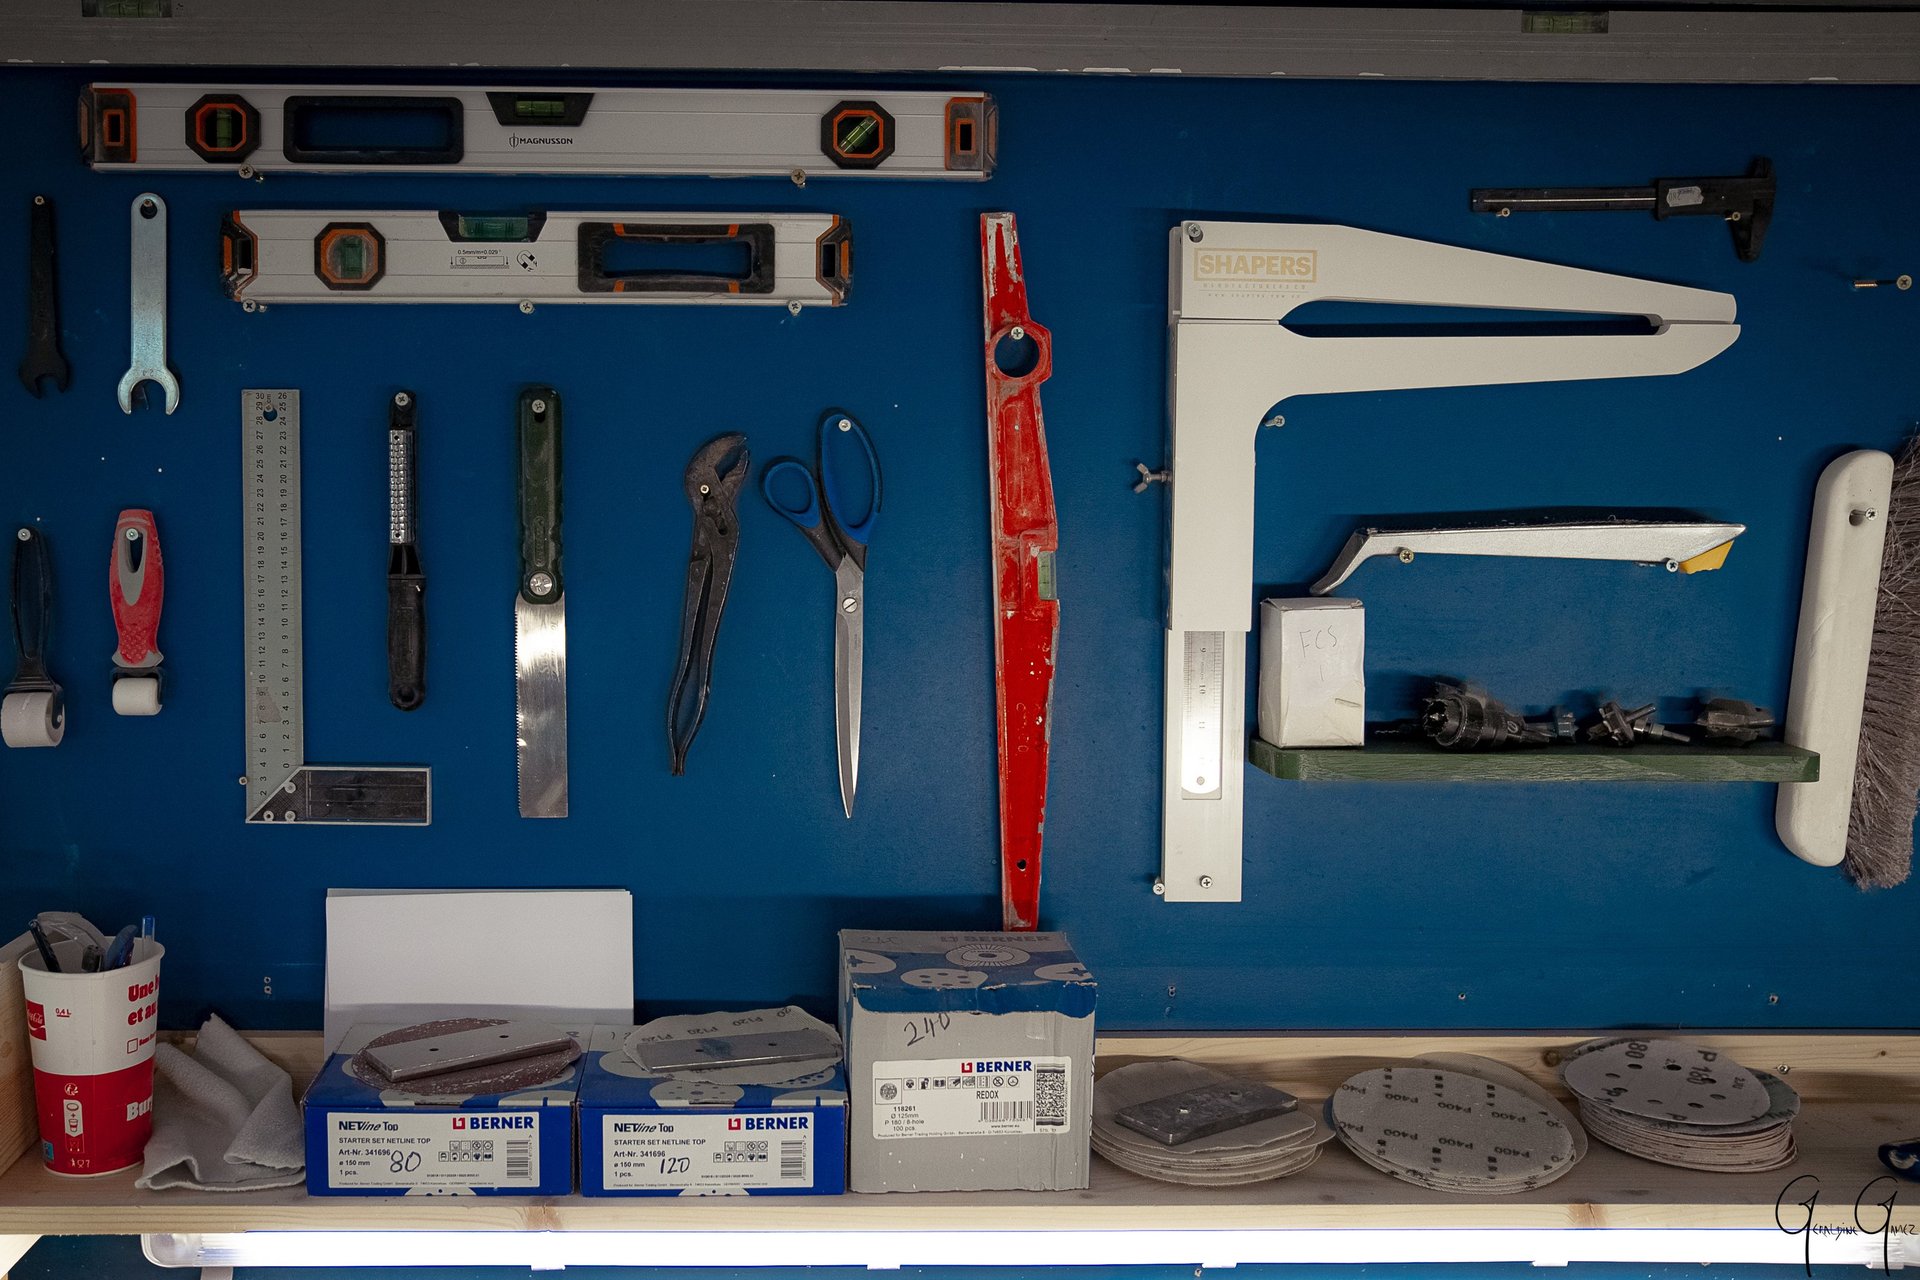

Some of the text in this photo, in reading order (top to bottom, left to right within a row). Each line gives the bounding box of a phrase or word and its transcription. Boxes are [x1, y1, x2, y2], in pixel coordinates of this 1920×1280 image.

[1200, 254, 1312, 276] SHAPERS
[256, 402, 263, 410] 29
[279, 402, 286, 411] 25
[256, 416, 263, 425] 28
[279, 417, 286, 425] 24
[256, 431, 263, 439] 27
[280, 431, 286, 440] 23
[256, 445, 263, 454] 26
[280, 446, 286, 454] 22
[256, 460, 263, 468] 25
[280, 460, 286, 468] 21
[257, 474, 263, 483] 24
[280, 475, 287, 483] 20
[257, 489, 264, 497] 23
[280, 489, 287, 497] 19
[257, 503, 264, 512] 22
[280, 504, 287, 512] 18
[257, 517, 264, 525] 21
[280, 518, 287, 526] 17
[257, 532, 264, 540] 20
[280, 532, 287, 540] 16
[257, 546, 264, 554] 19
[281, 547, 287, 555] 15
[258, 561, 264, 569] 18
[281, 561, 287, 569] 14
[258, 575, 264, 583] 17
[281, 575, 288, 583] 13
[258, 589, 265, 597] 16
[258, 603, 265, 611] 15
[258, 618, 265, 626] 14
[281, 618, 288, 627] 10
[258, 632, 265, 640] 13
[1300, 624, 1337, 658] FCS
[259, 646, 265, 654] 12
[259, 675, 265, 683] 10
[1199, 685, 1206, 694] 10
[128, 980, 154, 1002] Une
[128, 1007, 143, 1025] et
[732, 1016, 764, 1026] P120
[687, 1026, 718, 1035] P120
[904, 1012, 950, 1047] 240
[976, 1061, 1032, 1073] BERNER
[977, 1090, 999, 1099] REDOX
[1385, 1093, 1418, 1103] P400
[1438, 1102, 1471, 1113] P400
[1491, 1111, 1526, 1123] P400
[382, 1121, 399, 1131] Top
[470, 1116, 534, 1129] BERNER
[745, 1117, 809, 1130] BERNER
[658, 1123, 674, 1133] Top
[1384, 1129, 1418, 1140] P400
[1439, 1138, 1473, 1149] P400
[1494, 1147, 1530, 1158] P400
[390, 1150, 422, 1173] 80
[660, 1157, 690, 1174] 120
